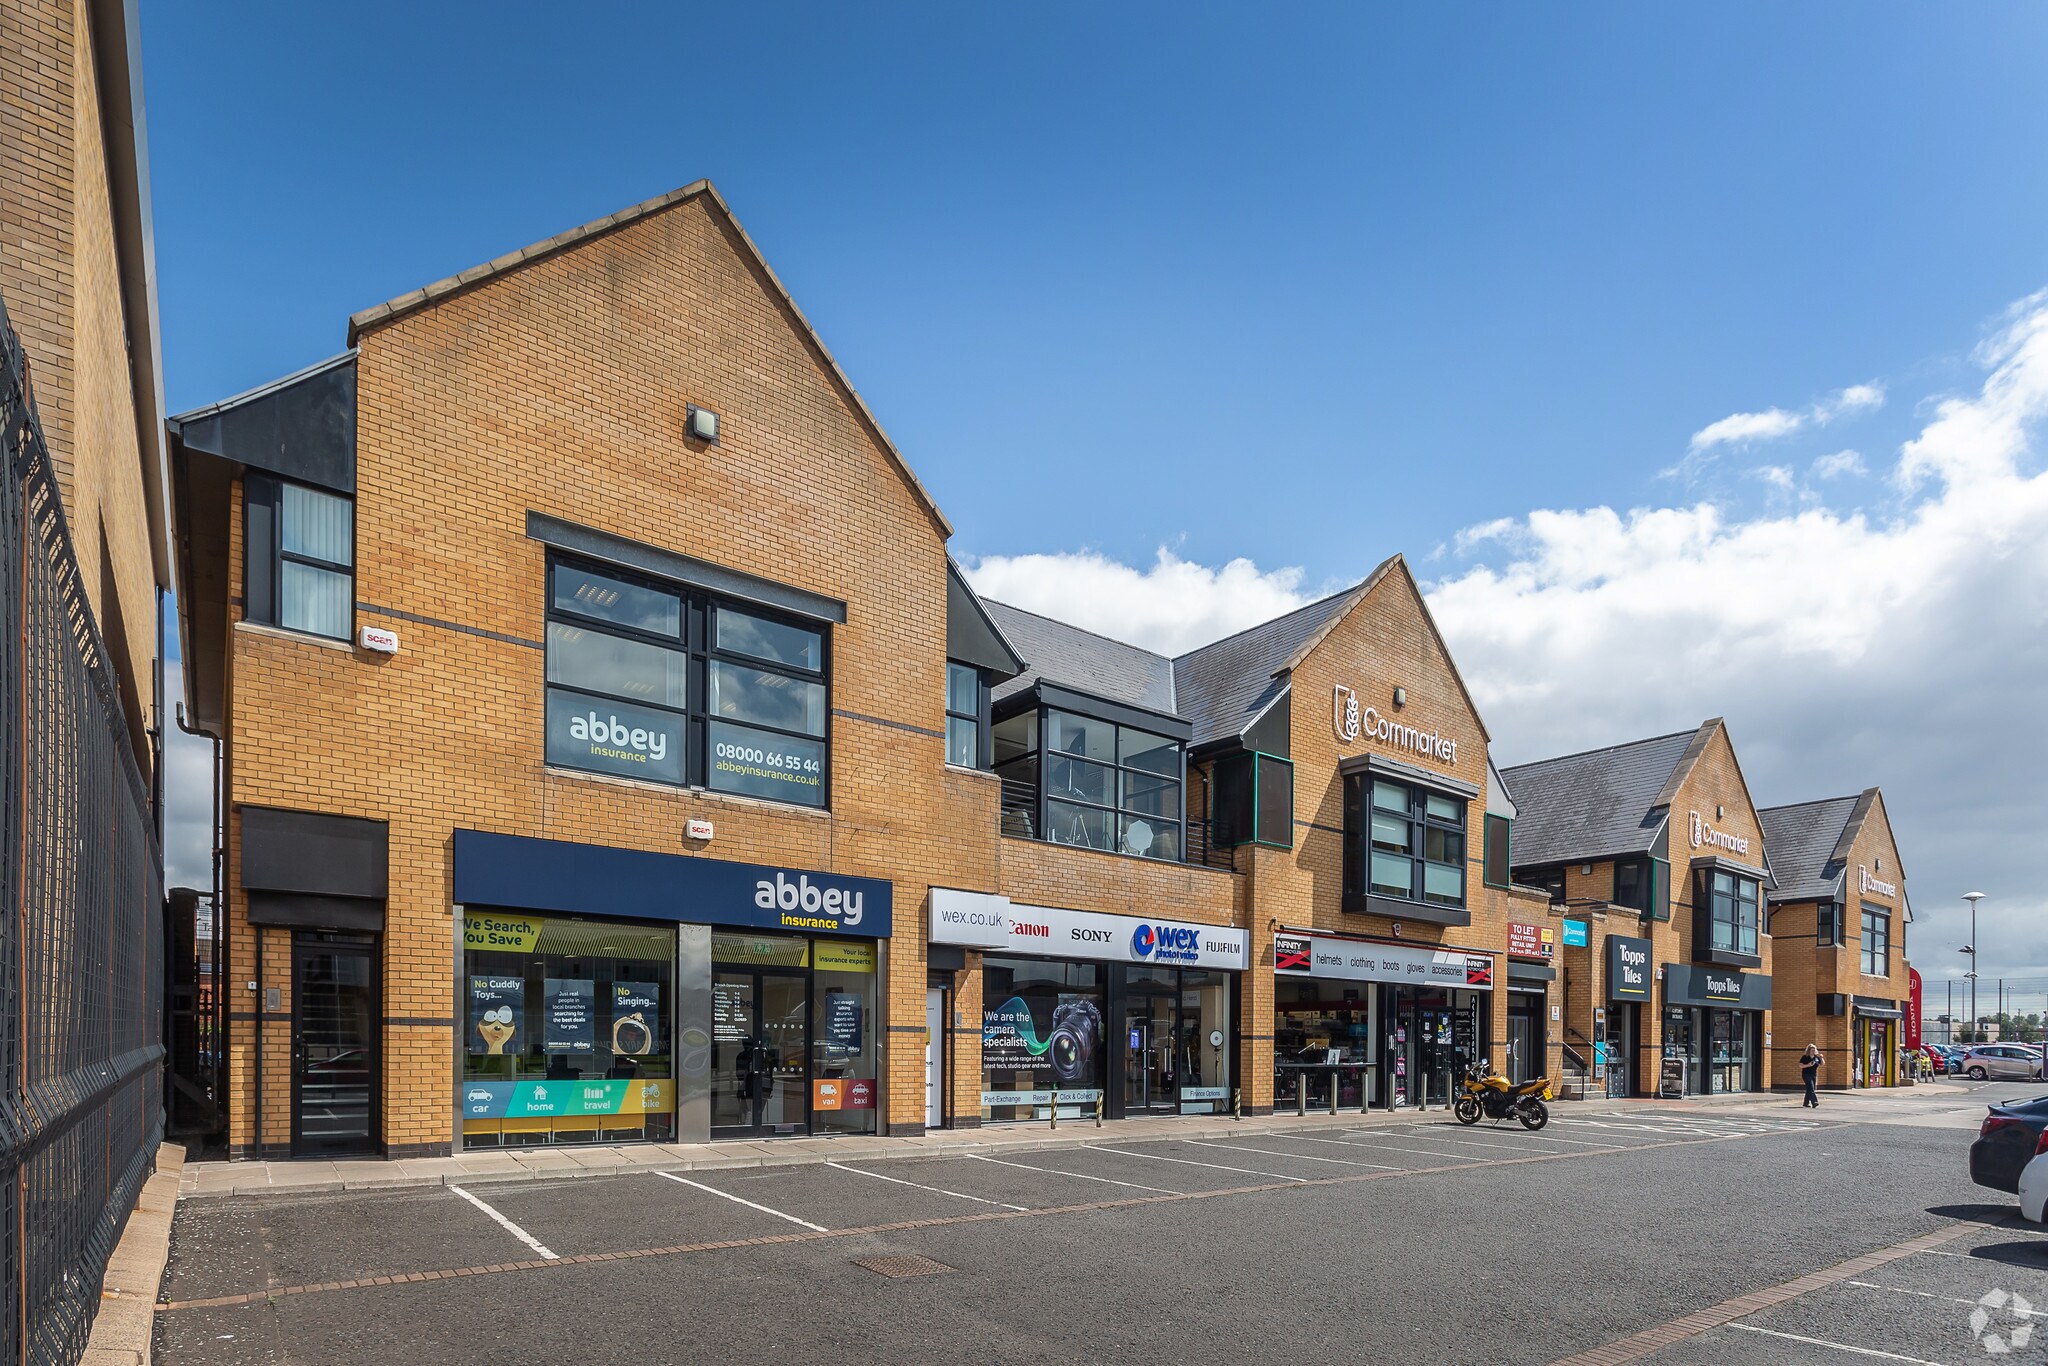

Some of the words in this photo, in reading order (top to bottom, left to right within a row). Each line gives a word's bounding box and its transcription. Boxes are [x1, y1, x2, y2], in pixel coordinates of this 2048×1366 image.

[366, 633, 393, 646] scan
[569, 711, 666, 760] abbey
[1363, 707, 1457, 763] Cornmarket
[591, 743, 646, 763] insurance
[716, 742, 763, 764] 08000
[766, 751, 783, 768] 66
[785, 755, 801, 770] 55
[803, 759, 820, 774] 44
[716, 760, 820, 786] abbeyinsurance.co.uk
[691, 826, 711, 835] scan
[1703, 822, 1749, 854] Cornmarket
[755, 872, 863, 925] abbey
[781, 912, 838, 929] insurance
[941, 910, 1003, 928] wex.co.uk
[484, 918, 535, 936] Search,
[1512, 924, 1523, 934] TO
[1523, 925, 1535, 935] LET
[488, 933, 522, 946] Save
[1071, 928, 1112, 943] SONY
[1155, 926, 1200, 950] wex
[1206, 941, 1240, 954] FUJIFILM
[1277, 940, 1302, 950] INFINITY
[843, 948, 857, 956] Your
[857, 949, 871, 957] local
[1620, 944, 1645, 966] Topps
[819, 955, 848, 965] insurance
[848, 956, 872, 966] experts
[1316, 953, 1343, 966] helmets
[1350, 957, 1375, 971] clothing
[1382, 959, 1400, 971] boots
[1406, 962, 1425, 975] gloves
[1431, 965, 1463, 977] accessories
[1623, 966, 1642, 984] Tiles
[474, 980, 488, 988] No
[489, 980, 520, 990] Cuddly
[1706, 975, 1726, 993] Topps
[1726, 977, 1740, 993] Tiles
[474, 990, 502, 1001] Toys...
[617, 987, 631, 996] No
[617, 997, 657, 1007] Singing...
[984, 1011, 999, 1021] We
[1000, 1013, 1014, 1021] are
[1016, 1012, 1030, 1022] the
[984, 1025, 1015, 1034] camera
[573, 1041, 591, 1049] abbey
[983, 1037, 1028, 1048] specialists
[642, 1099, 660, 1108] bike
[853, 1096, 868, 1105] taxi
[984, 1095, 1021, 1103] Part-Exchange
[1032, 1094, 1049, 1102] Repair
[472, 1105, 489, 1113] car
[527, 1102, 554, 1111] home
[584, 1100, 611, 1110] travel
